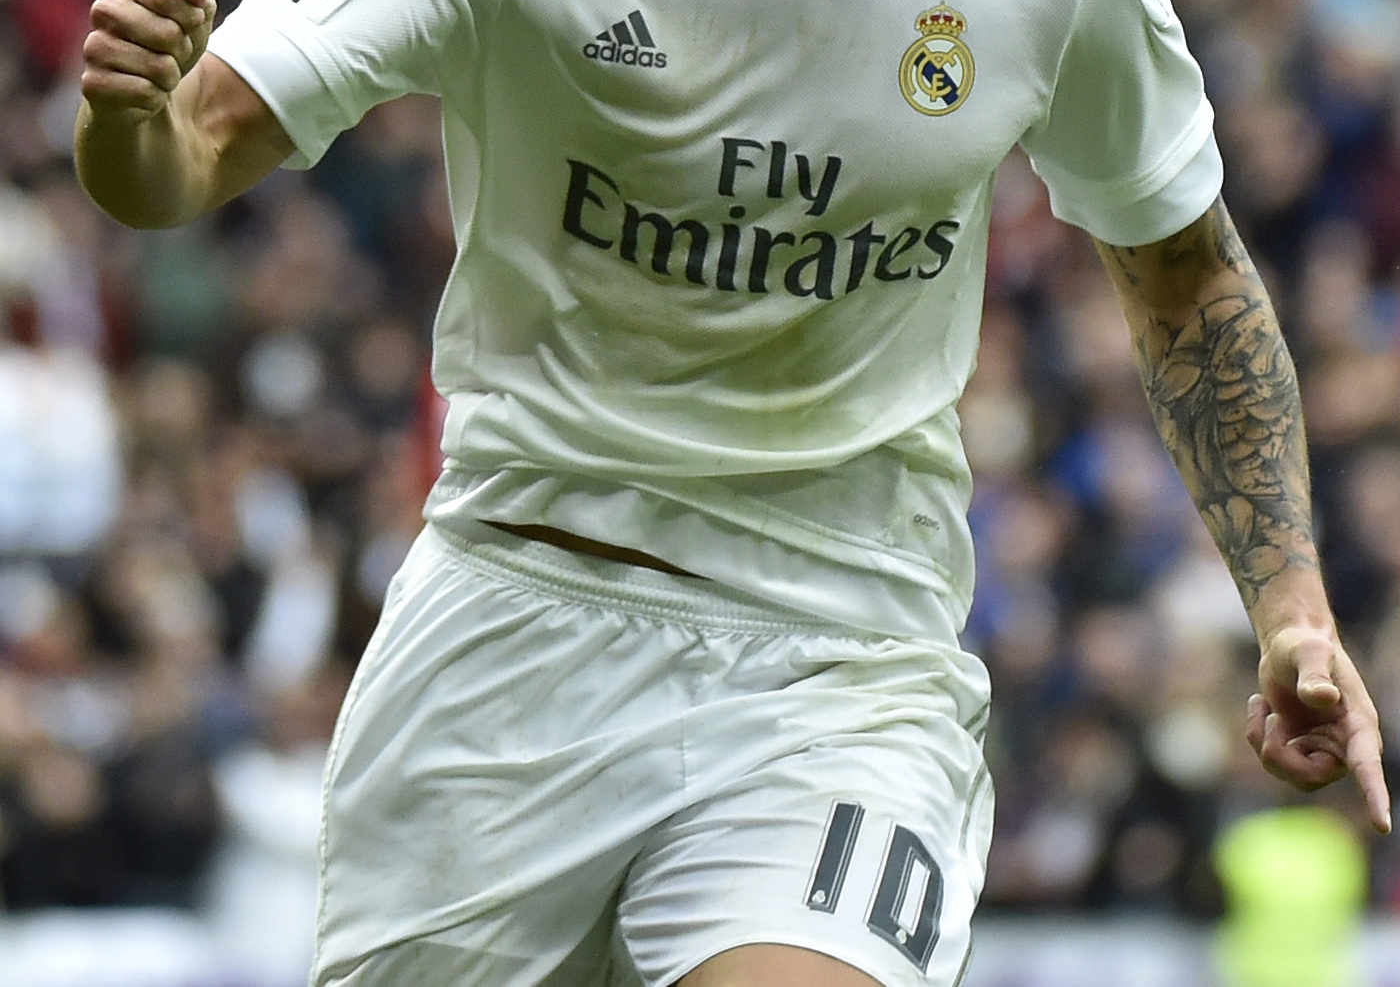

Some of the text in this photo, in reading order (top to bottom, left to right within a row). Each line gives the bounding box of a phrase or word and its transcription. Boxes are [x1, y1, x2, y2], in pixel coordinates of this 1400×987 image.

[583, 41, 667, 69] adidas
[562, 159, 960, 300] Emirates
[718, 137, 842, 216] Fly
[803, 799, 946, 976] 10
